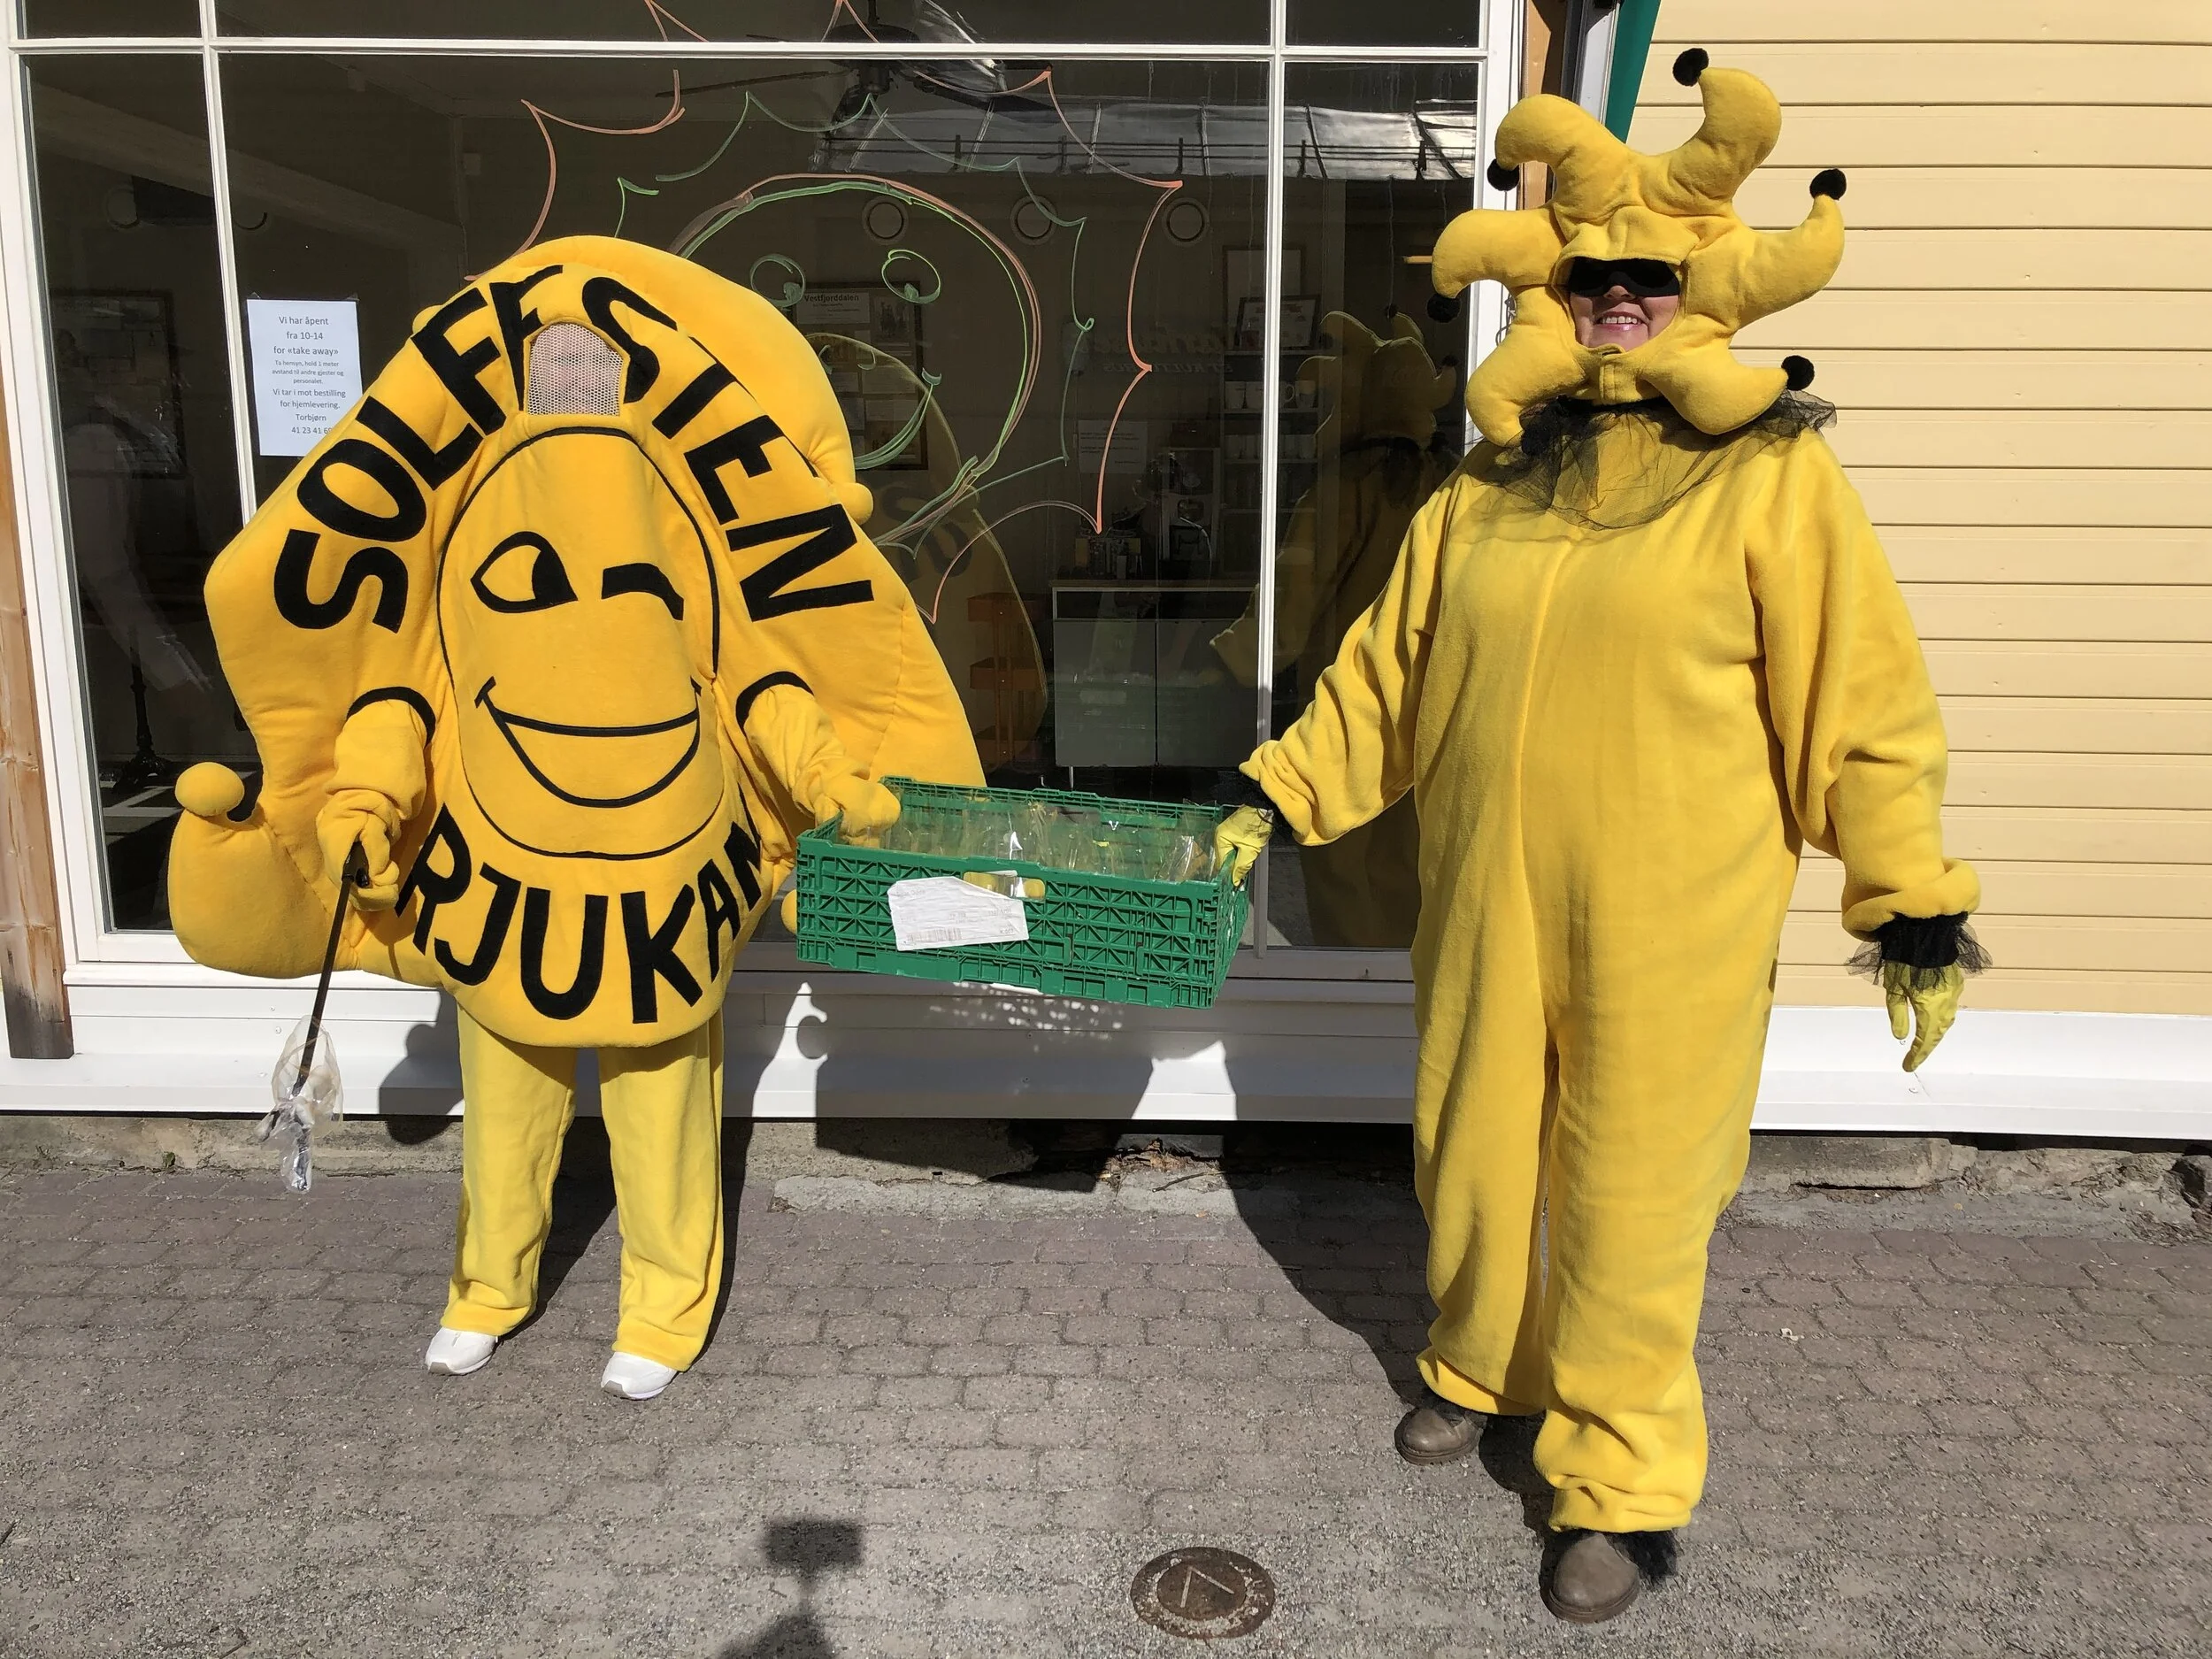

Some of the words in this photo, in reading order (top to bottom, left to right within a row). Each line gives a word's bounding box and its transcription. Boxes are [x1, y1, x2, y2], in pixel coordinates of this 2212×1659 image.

[803, 294, 859, 303] Vestfjorddalen
[289, 316, 302, 325] har
[305, 316, 329, 326] åpent
[286, 331, 298, 340] fra
[300, 331, 323, 340] 10-14
[313, 389, 346, 398] bestilling
[296, 413, 326, 422] Torbjørn
[395, 781, 761, 1024] RJUKAN
